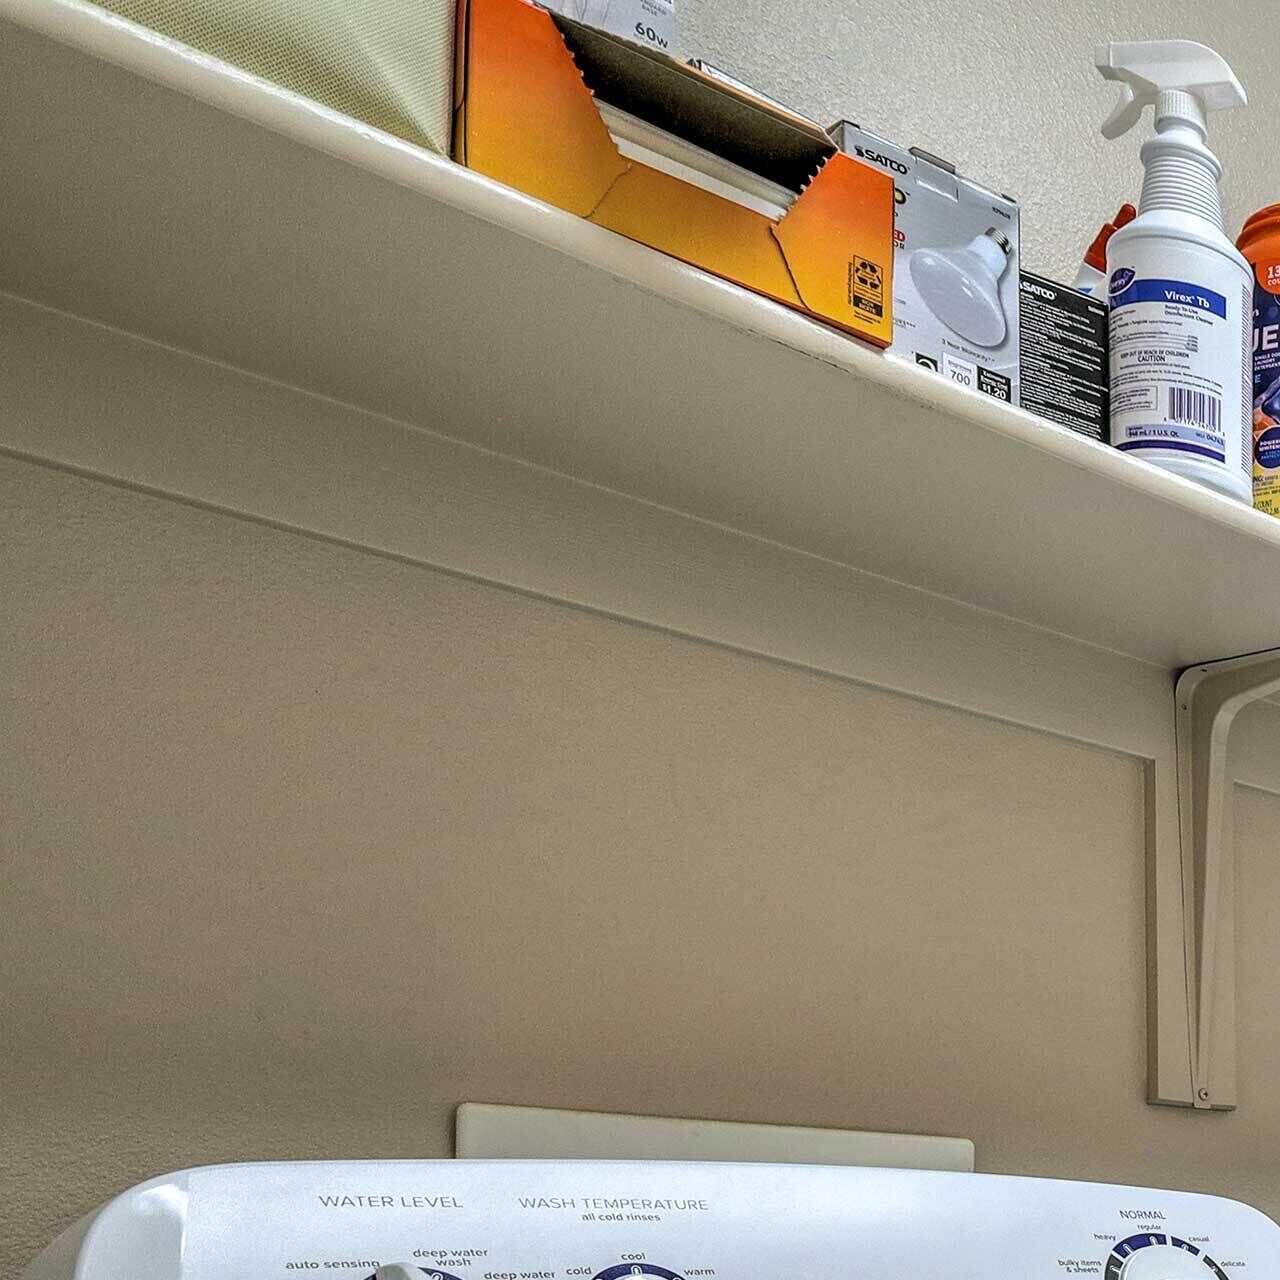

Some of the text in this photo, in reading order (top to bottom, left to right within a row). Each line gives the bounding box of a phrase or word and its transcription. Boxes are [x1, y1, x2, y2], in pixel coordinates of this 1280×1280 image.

[864, 149, 907, 175] SATCO
[1022, 282, 1055, 300] SATCO
[1137, 355, 1166, 363] CAUTION
[951, 369, 971, 386] 700
[318, 1195, 464, 1208] WATER LEVEL
[518, 1197, 709, 1211] WASH TEMPERATURE
[581, 1213, 661, 1222] all cold rinses
[1119, 1210, 1167, 1220] NORMAL
[413, 1248, 488, 1259] deep water
[621, 1252, 646, 1260] cool
[286, 1259, 380, 1271] auto sensing
[436, 1257, 472, 1266] wash
[484, 1270, 556, 1280] deep water
[566, 1267, 592, 1275] cold
[684, 1268, 715, 1276] warm
